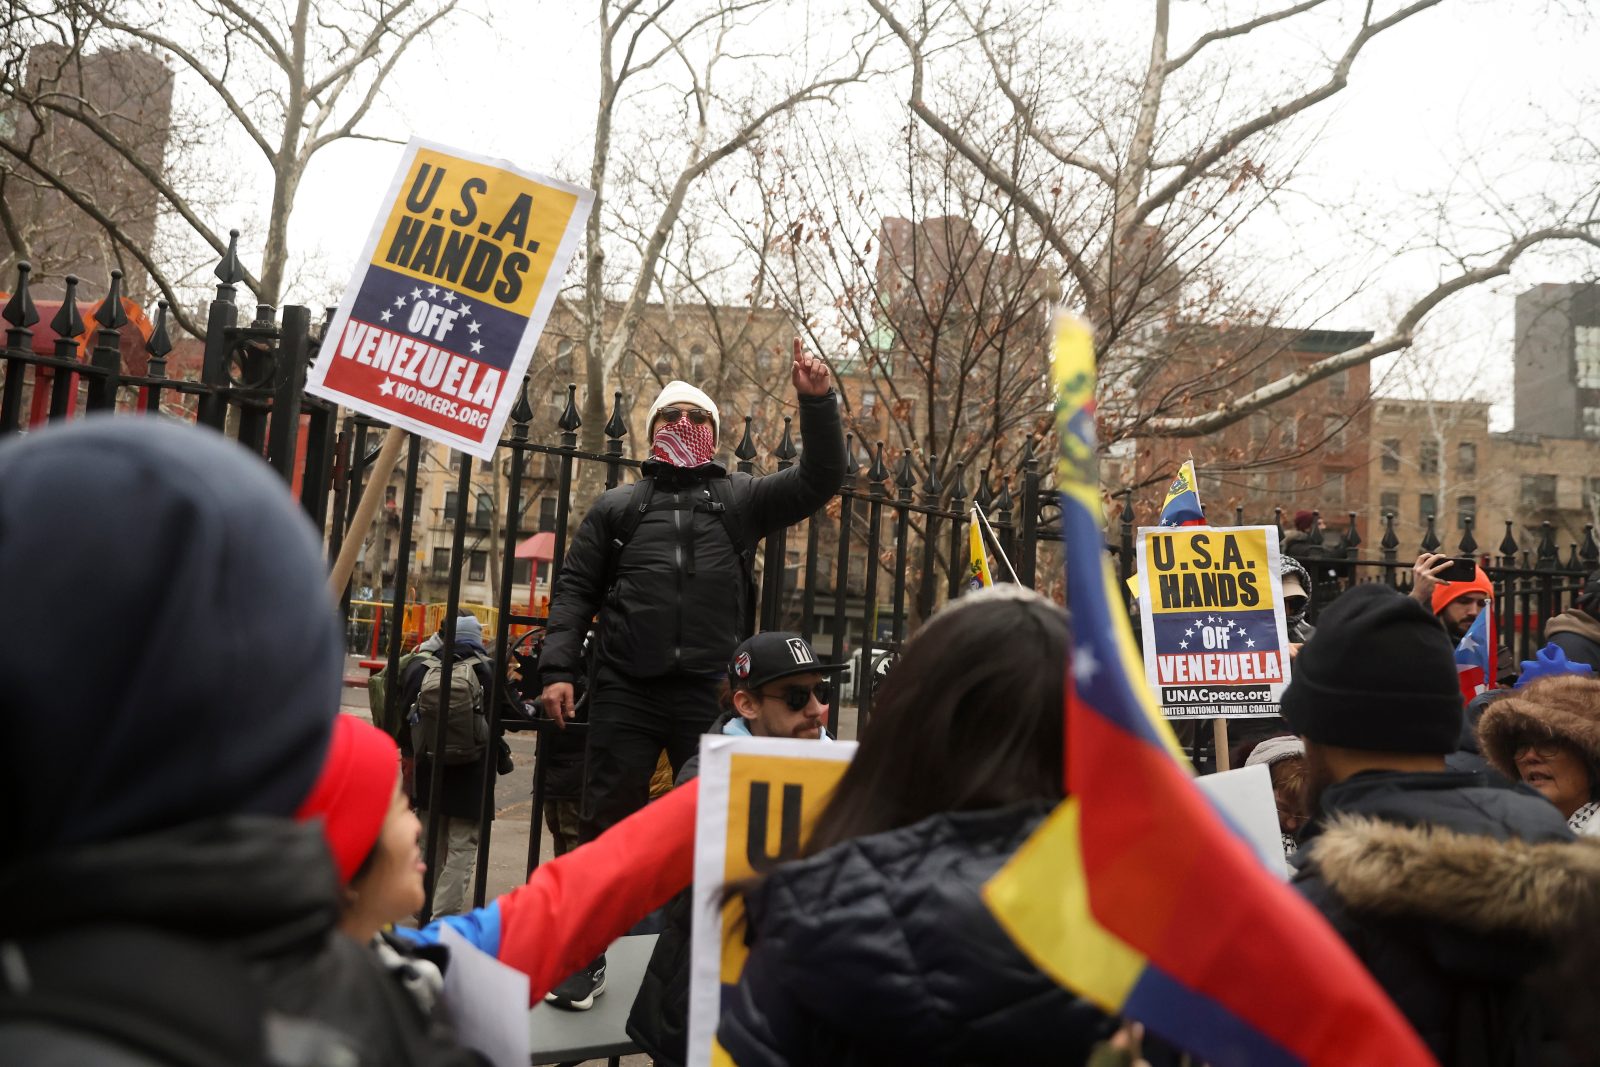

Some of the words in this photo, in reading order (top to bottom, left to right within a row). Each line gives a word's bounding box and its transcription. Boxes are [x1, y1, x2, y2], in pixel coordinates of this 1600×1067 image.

[405, 163, 541, 254] U.S.A.
[385, 215, 532, 304] HANDS
[408, 300, 460, 342] OFF
[340, 319, 503, 409] VENEZUELA
[396, 381, 490, 429] WORKERS.ORG
[1152, 533, 1256, 571] U.S.A.
[1158, 571, 1260, 609] HANDS
[1202, 626, 1230, 650] OFF
[1158, 652, 1281, 683] VENEZUELA
[1160, 706, 1185, 716] UNITED
[1186, 705, 1220, 715] NATIONAL
[1249, 704, 1281, 713] COALITIO
[1166, 688, 1272, 703] UNACpeace.org
